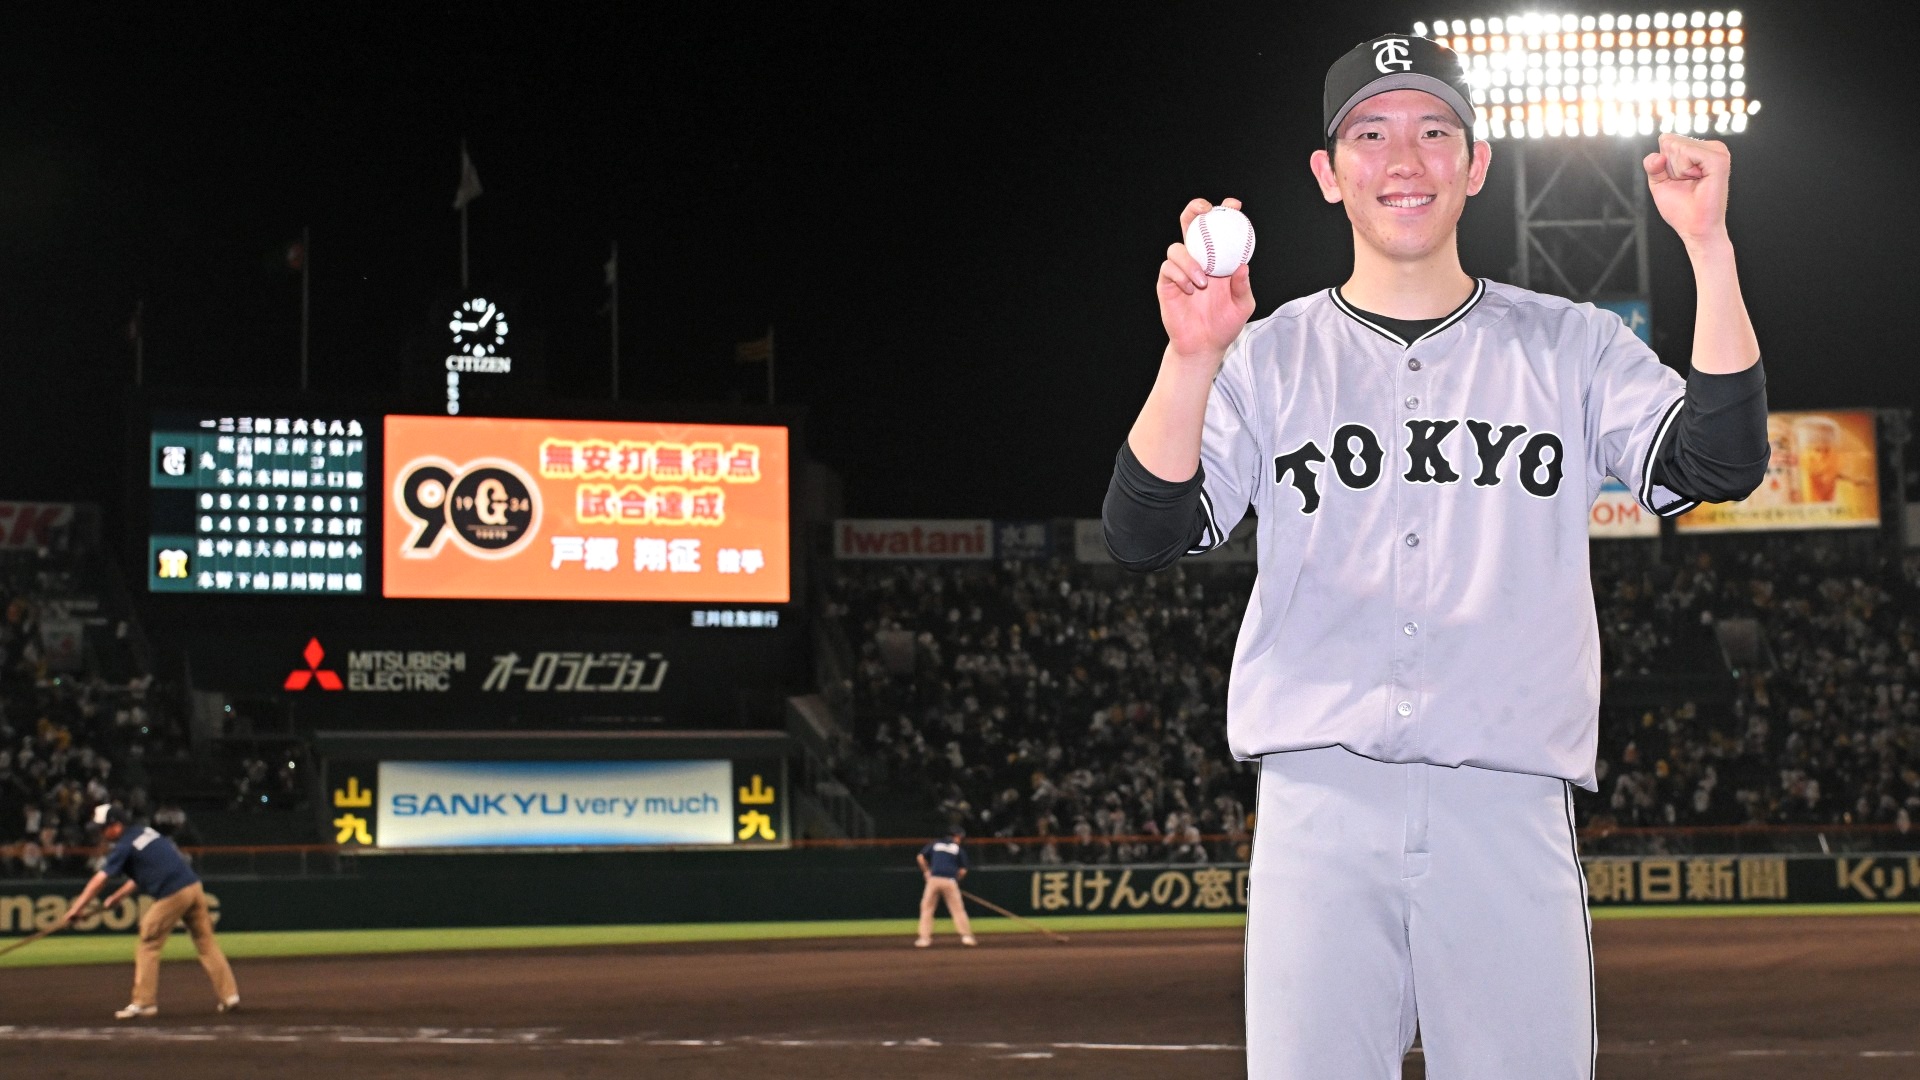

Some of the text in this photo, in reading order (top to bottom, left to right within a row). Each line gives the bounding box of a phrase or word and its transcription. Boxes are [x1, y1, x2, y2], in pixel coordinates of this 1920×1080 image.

[445, 355, 512, 373] CITIZEN
[542, 440, 758, 480] 無安打無得点
[1274, 417, 1565, 516] TOKYO
[579, 486, 722, 523] 試合達成
[842, 523, 986, 555] Iwatani
[348, 650, 466, 672] MITSUBISHI
[482, 652, 668, 692] オーロラビジョン
[348, 671, 450, 692] ELECTRIC
[334, 778, 373, 845] 山九
[392, 792, 719, 819] SANKYU very much
[738, 776, 777, 841] 山九
[1586, 857, 1787, 902] 朝日新聞
